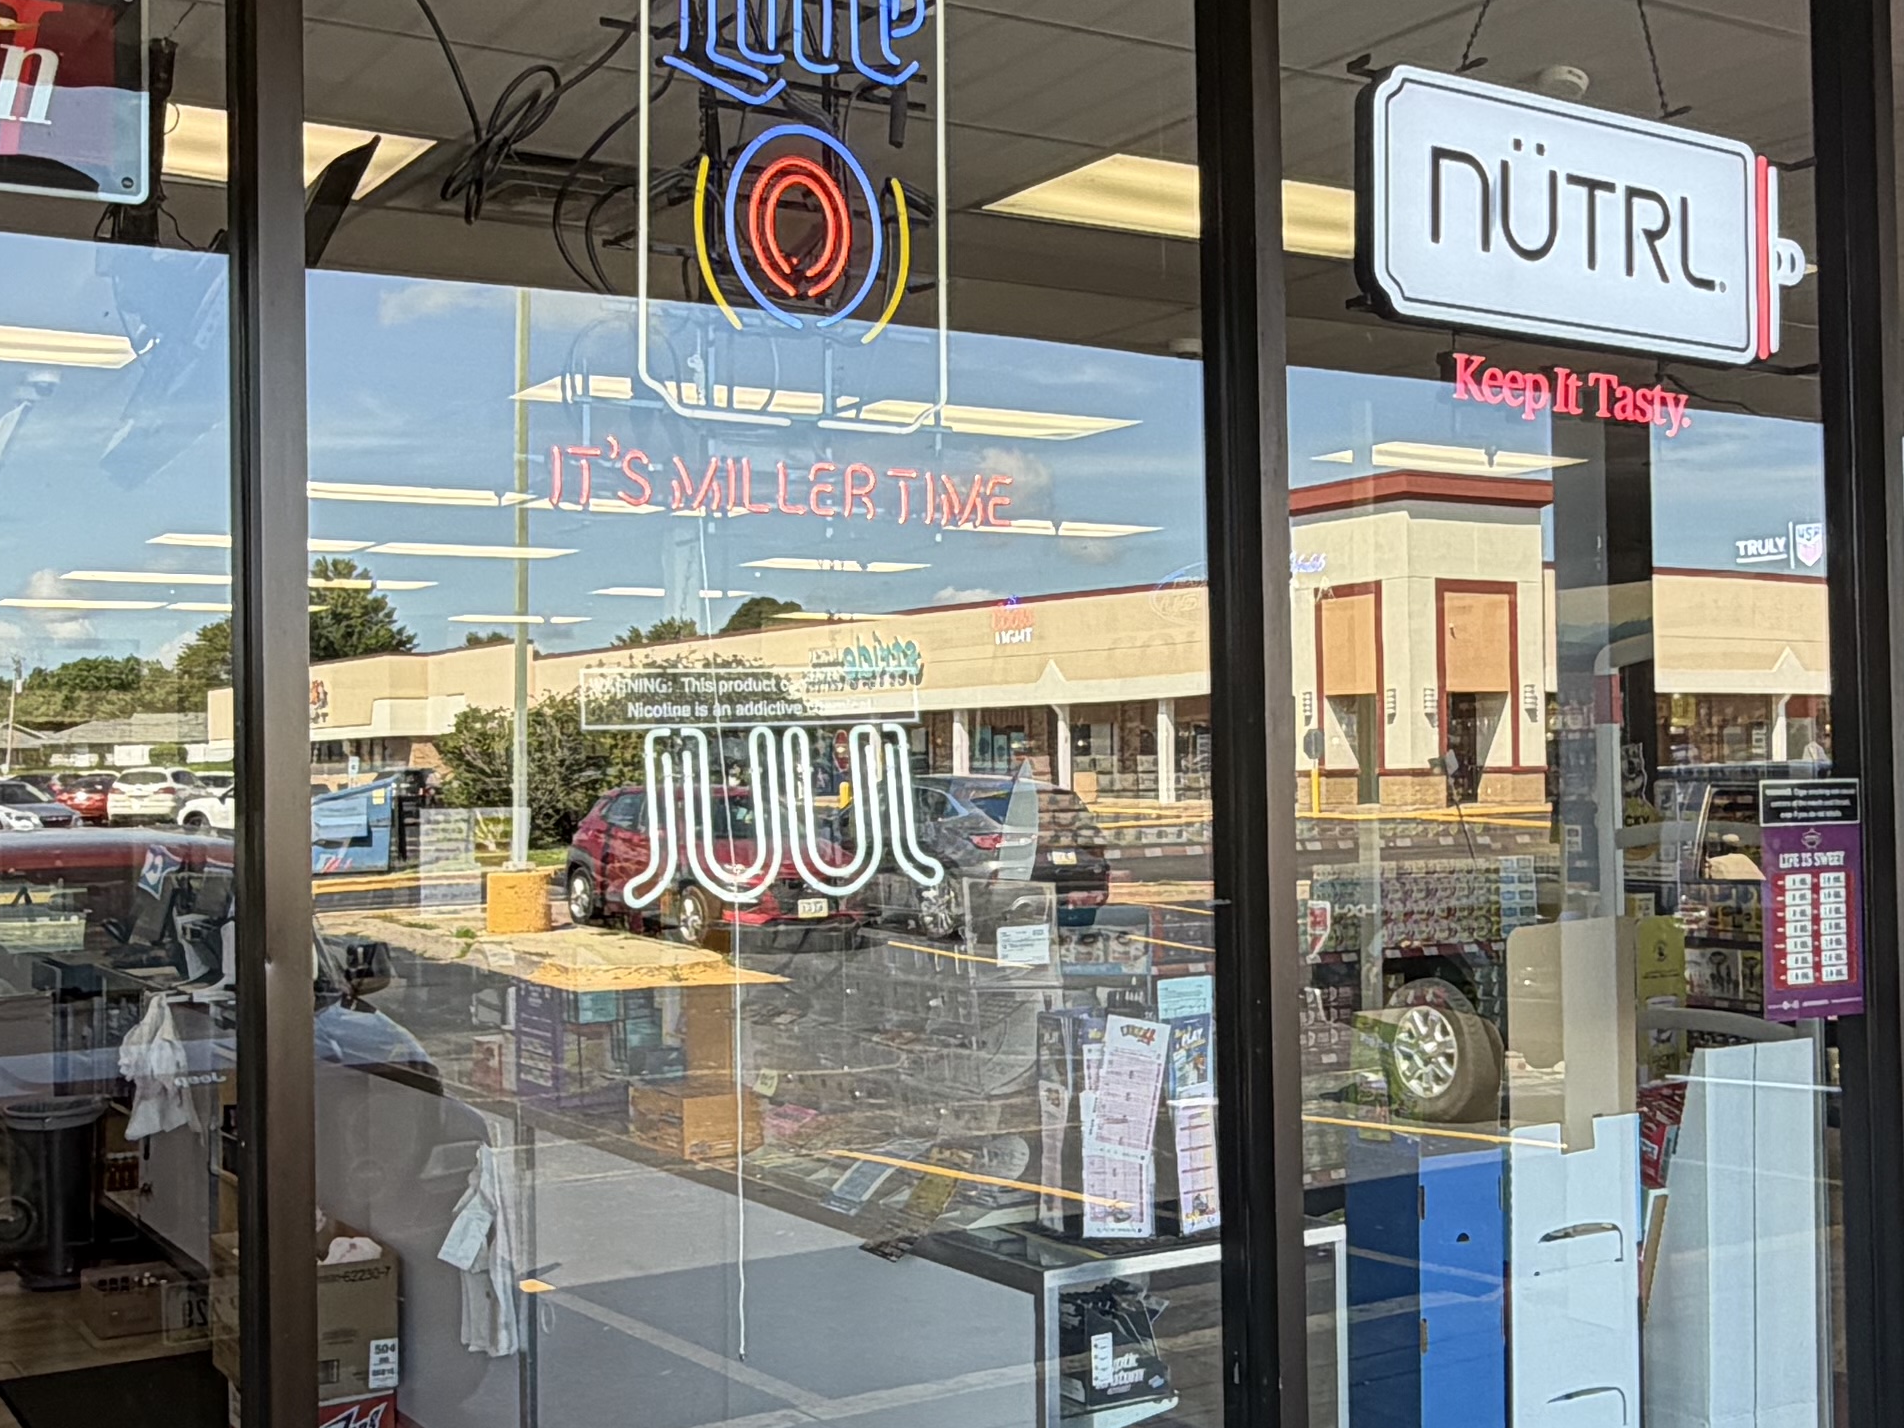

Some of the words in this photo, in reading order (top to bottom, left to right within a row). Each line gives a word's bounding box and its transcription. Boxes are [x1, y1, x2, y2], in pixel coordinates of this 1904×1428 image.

[1452, 352, 1549, 421] Keep
[1554, 368, 1583, 415] It
[1589, 372, 1692, 438] Tasty.
[549, 435, 652, 508] IT'S
[670, 455, 877, 520] MILLER
[886, 467, 1014, 527] TIME
[1735, 536, 1787, 556] TRULY
[681, 676, 714, 694] This
[719, 675, 777, 698] product
[627, 700, 691, 719] Nicotine
[694, 701, 709, 717] is
[713, 702, 732, 718] an
[735, 699, 803, 718] addictive
[623, 722, 943, 909] JUUL
[1779, 853, 1800, 869] LIFE
[1801, 852, 1813, 867] IS
[1814, 850, 1846, 867] SWEET
